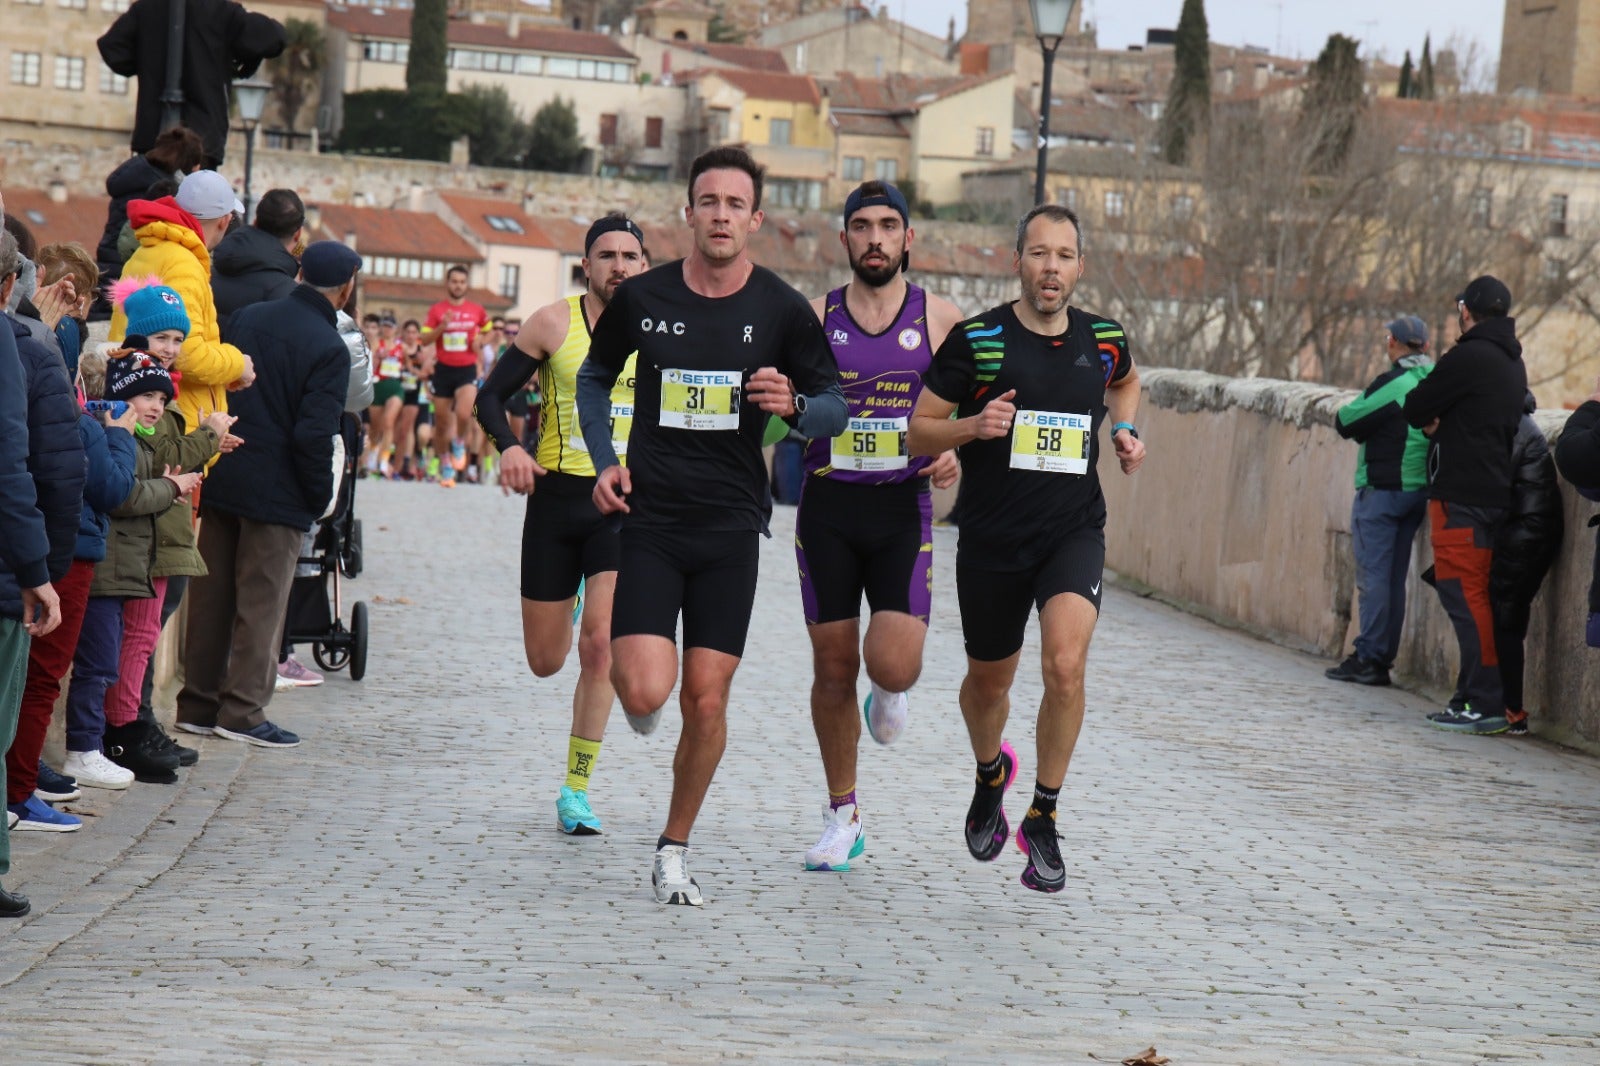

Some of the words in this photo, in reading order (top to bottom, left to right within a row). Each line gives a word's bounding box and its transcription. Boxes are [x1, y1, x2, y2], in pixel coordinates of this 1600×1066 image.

[641, 318, 686, 335] OAC
[112, 370, 145, 393] MERRY
[682, 373, 733, 385] SETEL
[876, 381, 911, 393] PRIM
[686, 386, 705, 409] 31
[865, 396, 913, 408] Macotera
[850, 421, 900, 431] SETEL
[1037, 415, 1085, 428] SETEL
[853, 432, 876, 453] 56
[1036, 427, 1062, 452] 58
